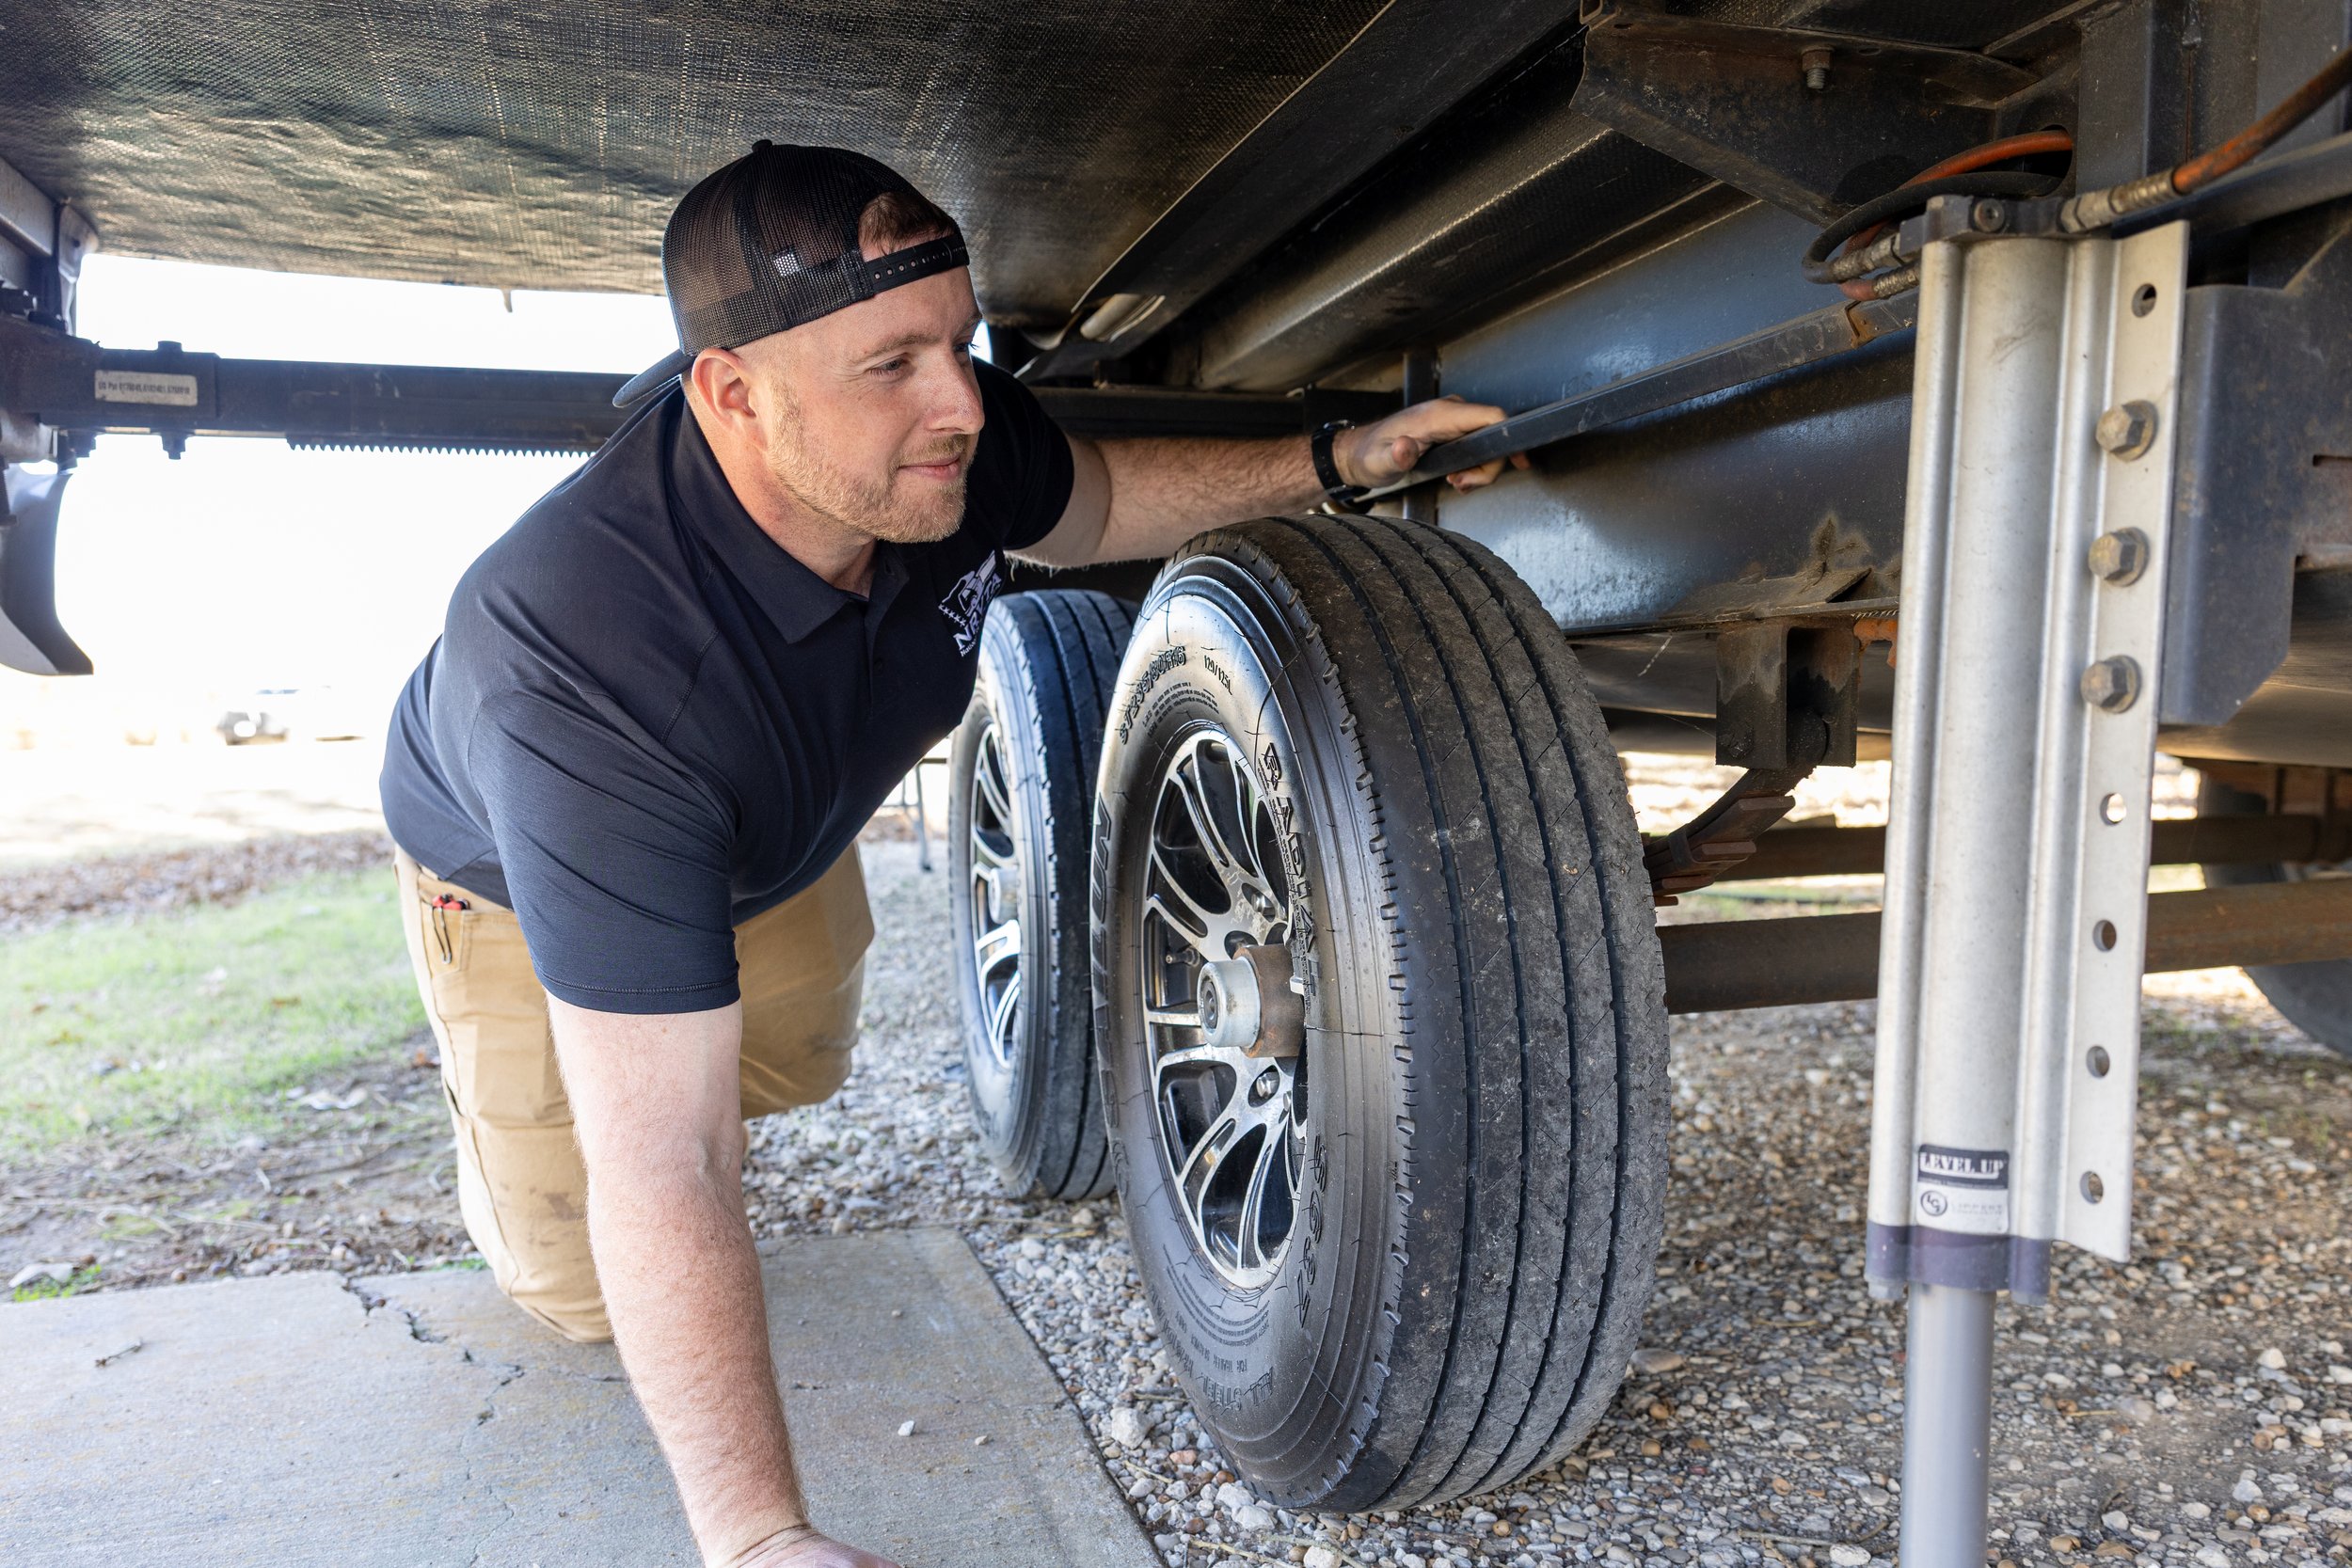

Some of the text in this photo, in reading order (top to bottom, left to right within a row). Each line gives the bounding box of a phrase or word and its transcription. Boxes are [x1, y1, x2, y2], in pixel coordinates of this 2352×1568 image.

[1091, 792, 1120, 1129] SAILUN
[1919, 1152, 2005, 1174] LEVEL UP
